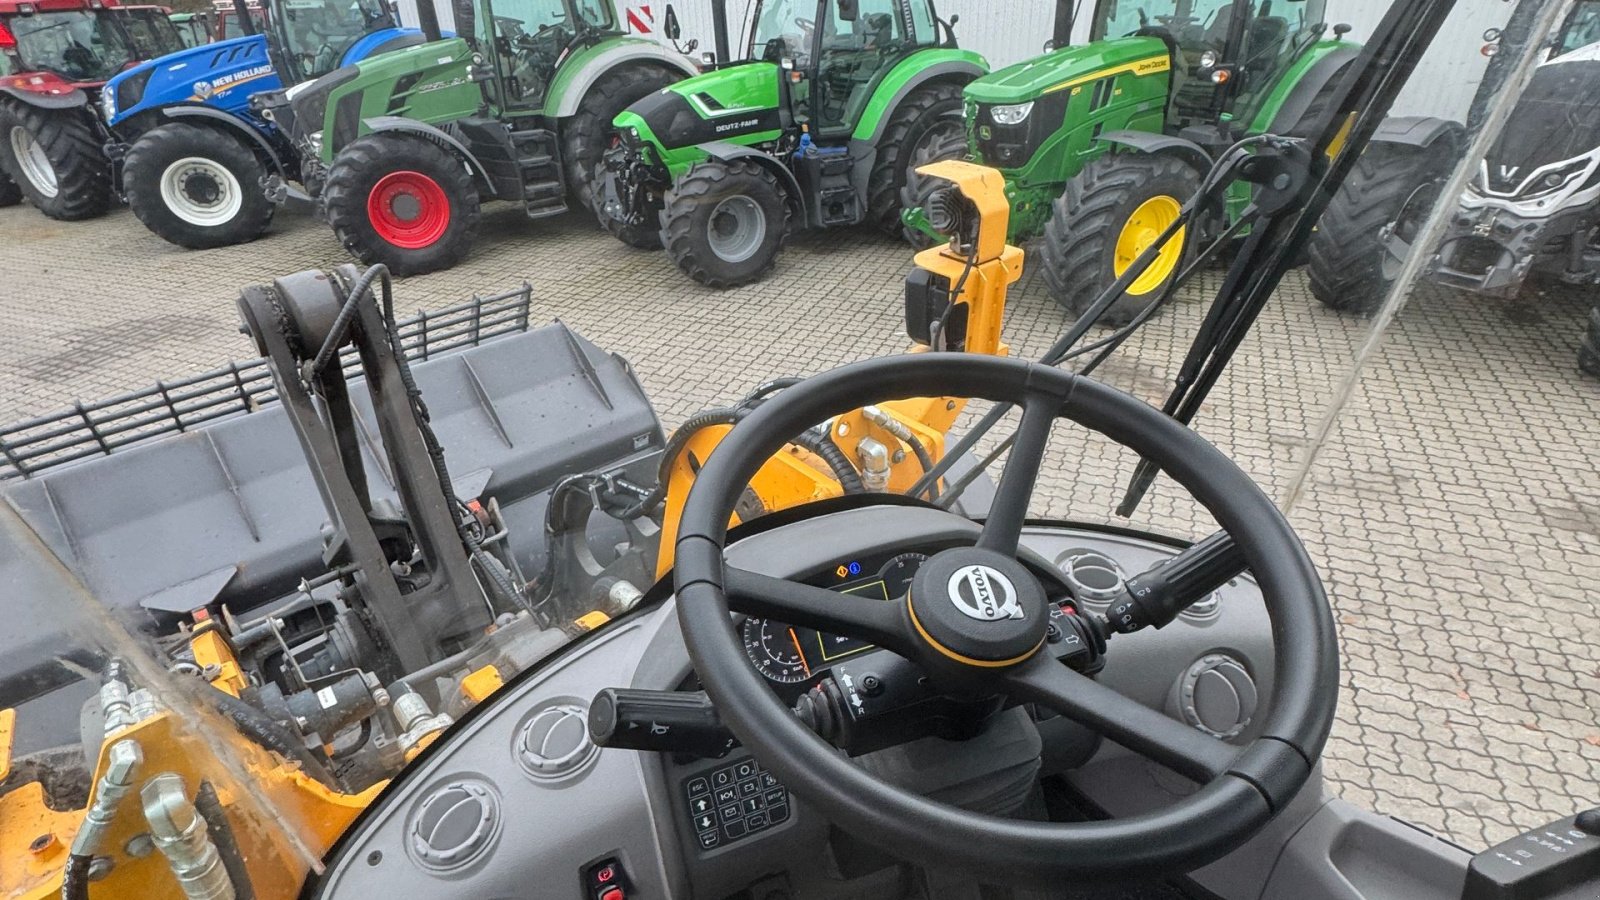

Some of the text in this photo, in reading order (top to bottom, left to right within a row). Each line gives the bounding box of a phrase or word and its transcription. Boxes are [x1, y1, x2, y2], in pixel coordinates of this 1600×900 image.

[1138, 60, 1167, 71] JOHN DEERE
[212, 64, 272, 88] NEW HOLLAND
[715, 119, 759, 132] DEUTZ-FAHR
[971, 567, 995, 618] VOLVO
[840, 666, 846, 674] F
[858, 707, 865, 715] R
[767, 791, 782, 800] SETUP
